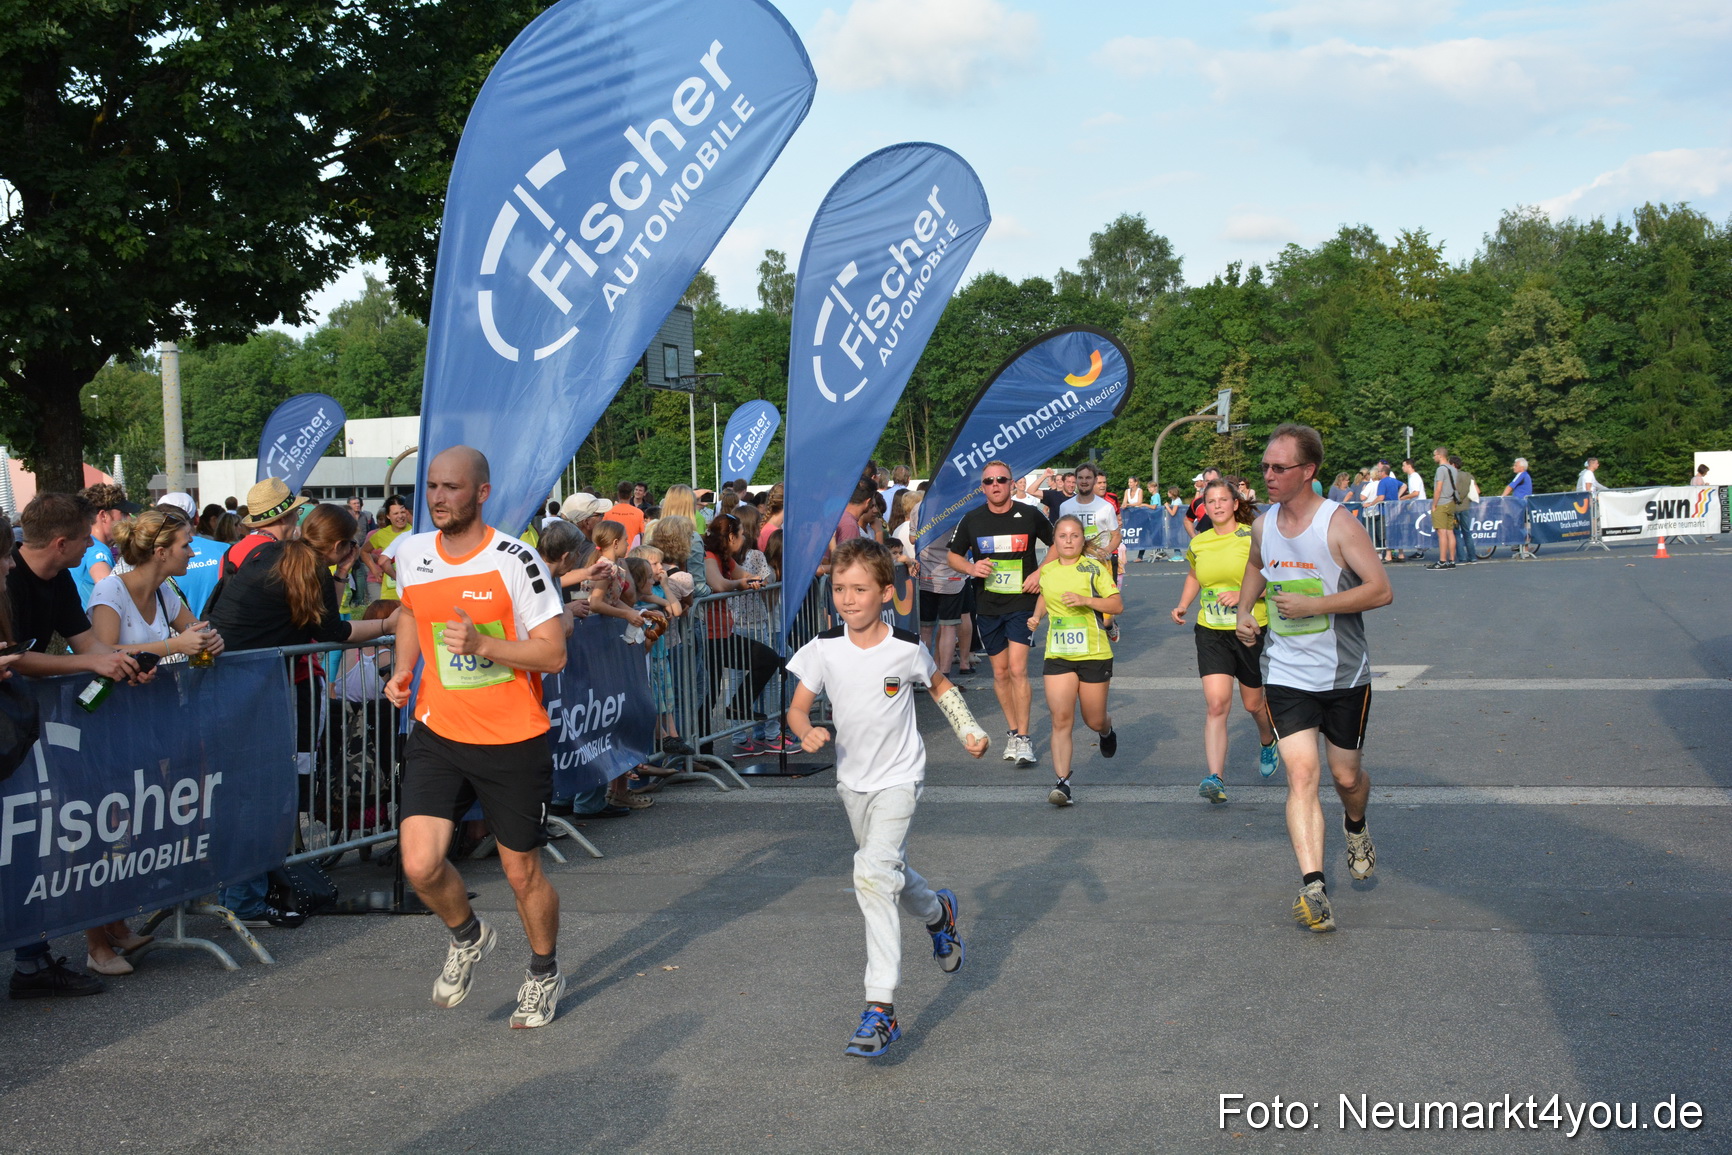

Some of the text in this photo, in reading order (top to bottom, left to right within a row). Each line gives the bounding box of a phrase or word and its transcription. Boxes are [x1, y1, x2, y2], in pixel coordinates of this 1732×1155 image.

[527, 39, 733, 315] Fischer
[602, 94, 756, 313] AUTOMOBILE
[838, 185, 948, 370] Fischer
[877, 219, 960, 368] AUTOMOBILE
[735, 411, 768, 463] Fischer
[952, 389, 1079, 477] Frischmann
[1035, 380, 1122, 440] Druck und Medien
[278, 407, 327, 473] Fischer
[295, 419, 333, 471] AUTOMOBILE
[747, 420, 772, 462] AUTOMOBILE
[1531, 508, 1578, 524] Frischmann
[416, 565, 434, 574] erima
[995, 573, 1011, 584] 37
[1281, 561, 1318, 570] KLEBL
[1053, 631, 1084, 645] 1180
[547, 688, 626, 743] Fischer
[0, 769, 223, 867] Fischer
[24, 833, 211, 905] AUTOMOBILE
